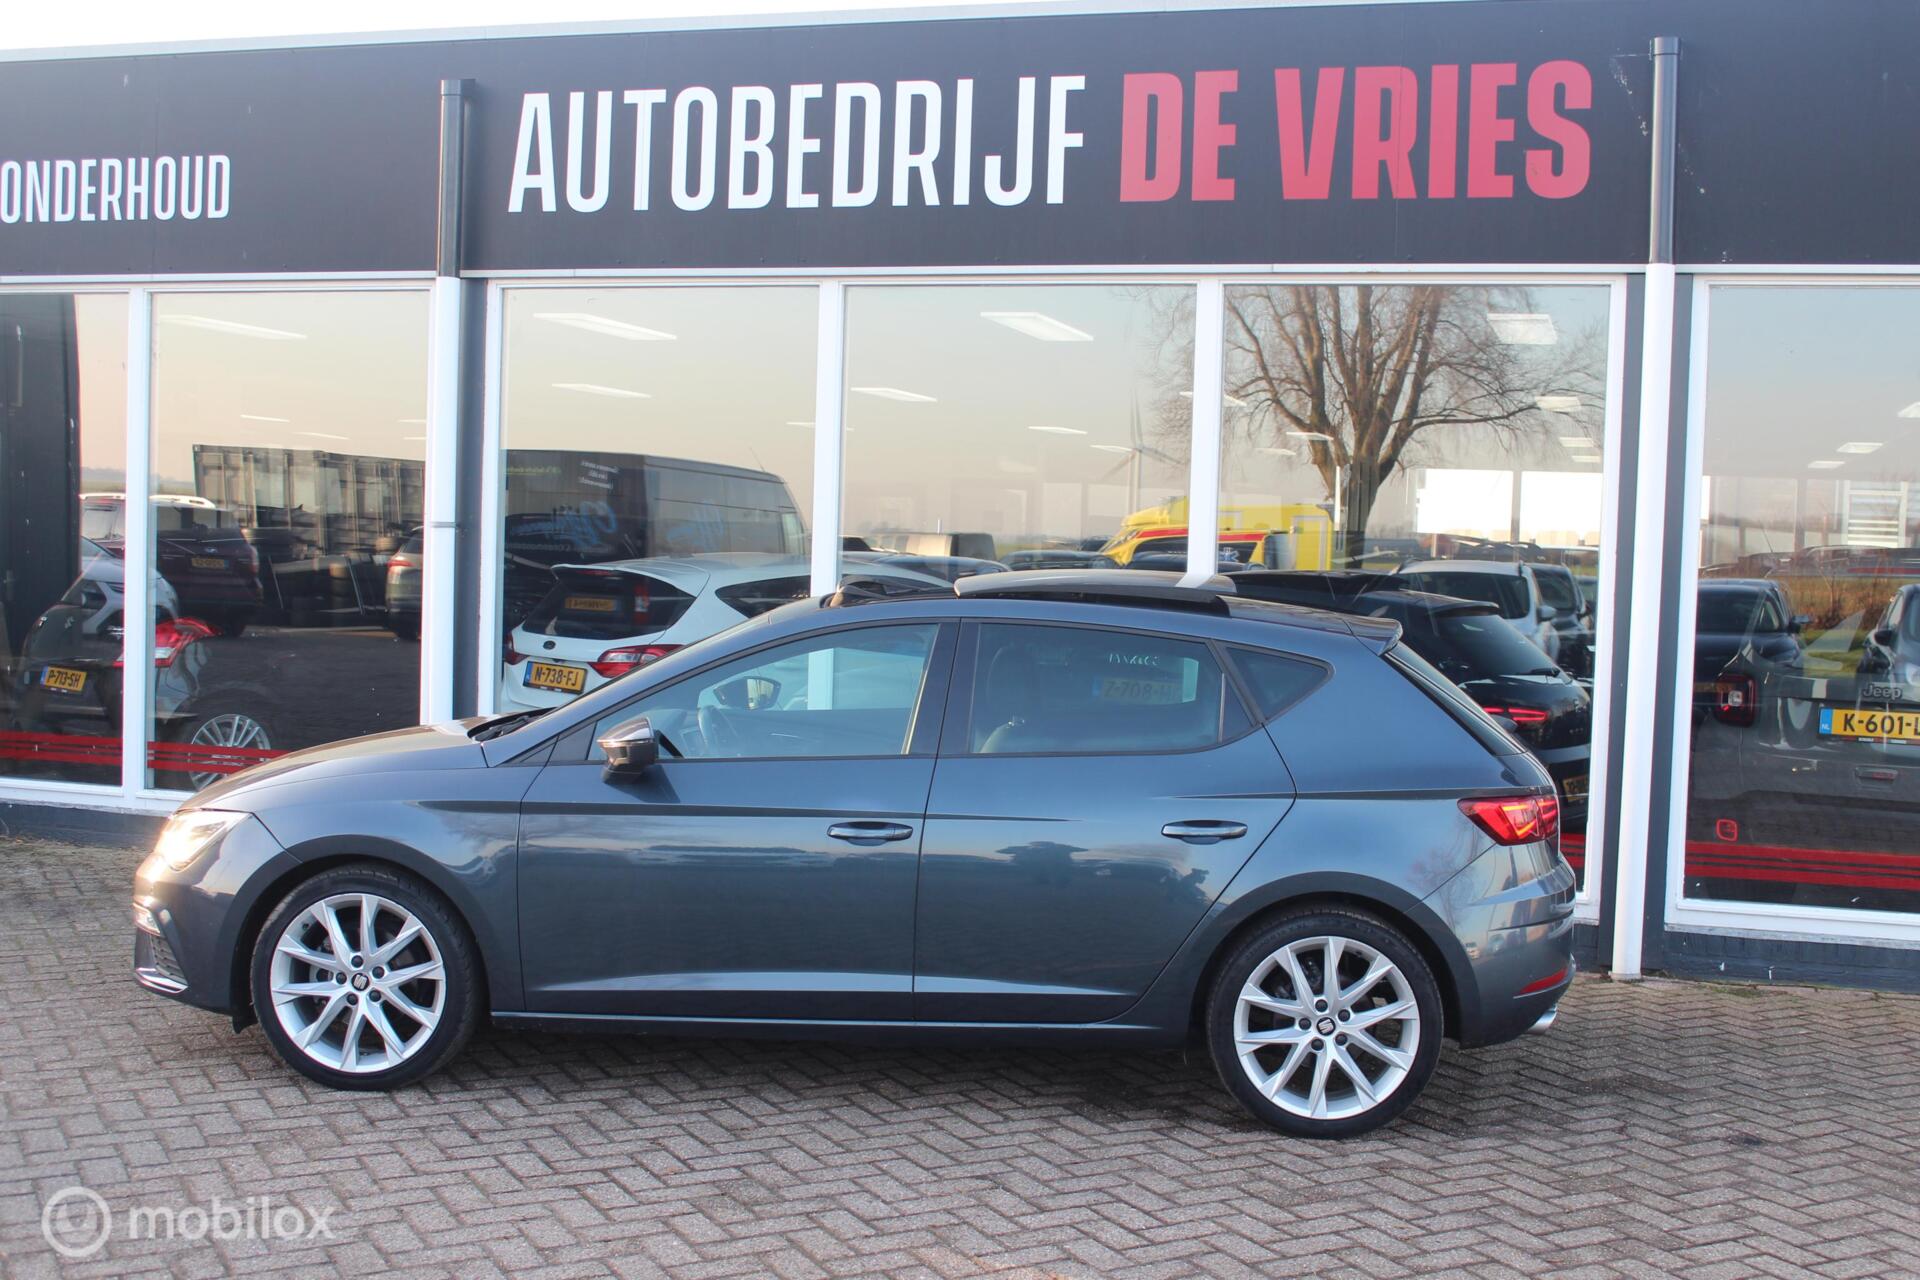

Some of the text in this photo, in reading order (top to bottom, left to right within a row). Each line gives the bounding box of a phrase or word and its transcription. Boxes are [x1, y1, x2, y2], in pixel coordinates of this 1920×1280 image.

[508, 60, 1592, 213] AUTOBEDRIJF DE VRIES
[1, 154, 230, 224] ONDERHOUD
[534, 665, 580, 687] N-738-FJ
[1863, 684, 1901, 700] Jeep
[1821, 723, 1831, 731] NL
